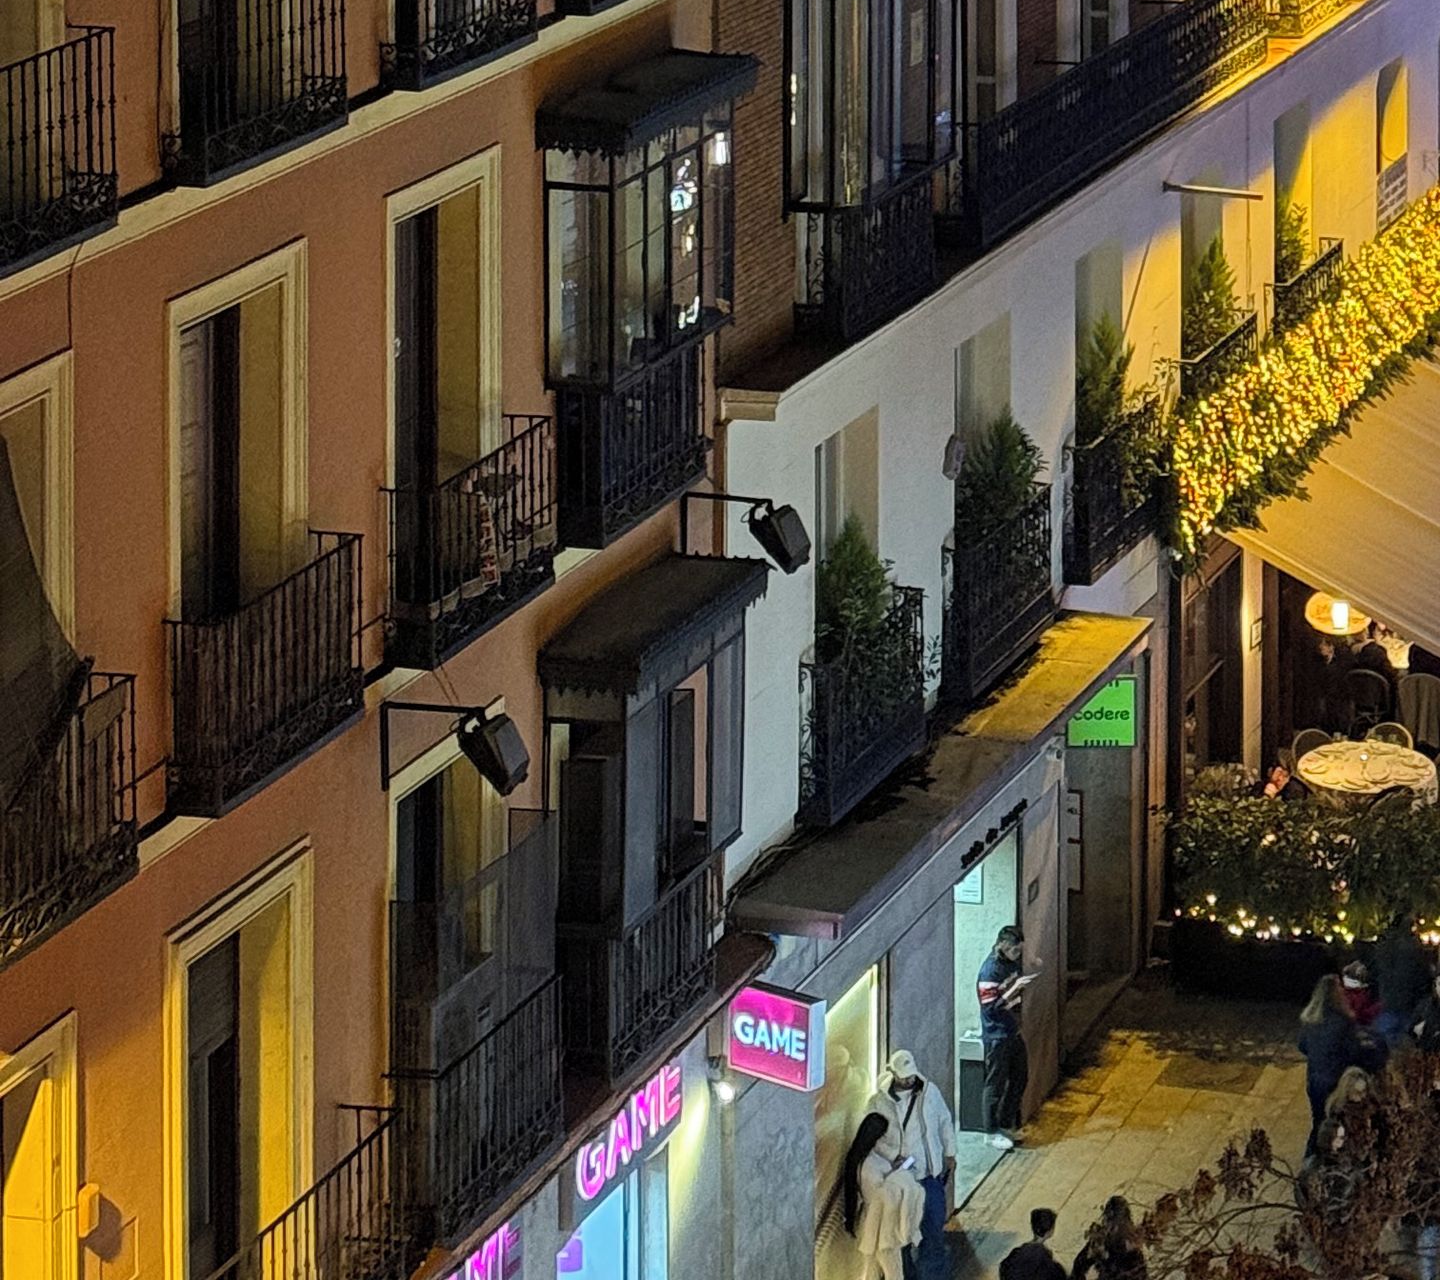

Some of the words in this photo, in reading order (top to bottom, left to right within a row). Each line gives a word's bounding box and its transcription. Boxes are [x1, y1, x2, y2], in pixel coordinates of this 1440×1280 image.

[1073, 706, 1131, 721] codere
[733, 1013, 806, 1062] GAME
[576, 1063, 683, 1201] GAME
